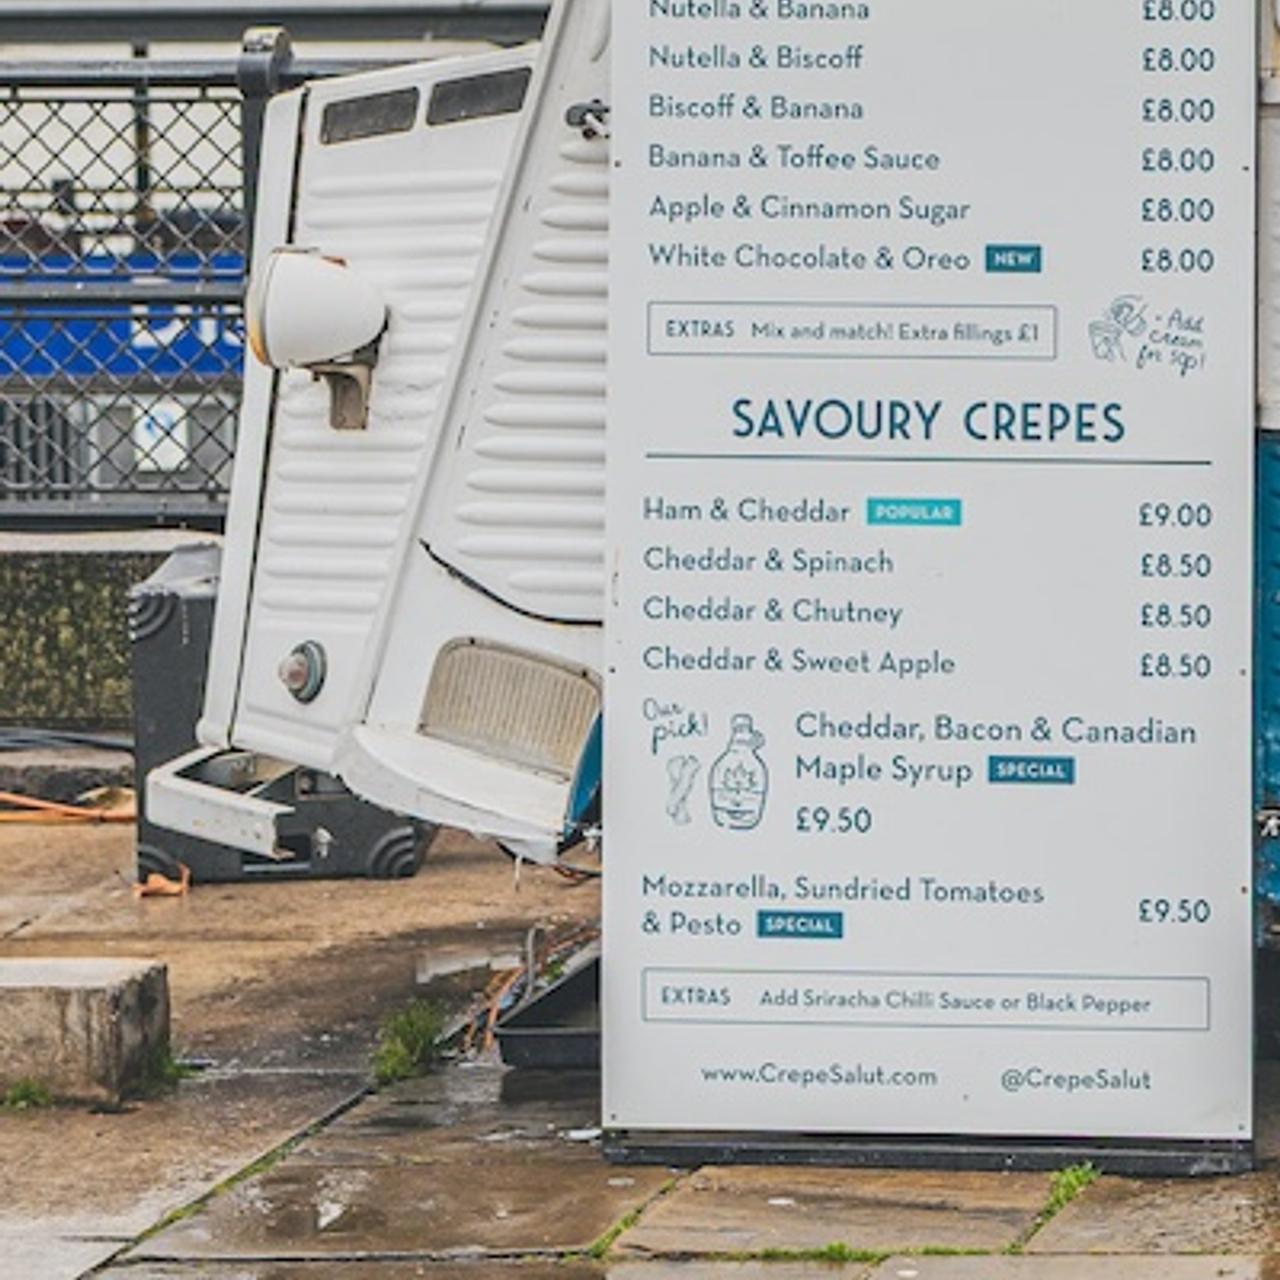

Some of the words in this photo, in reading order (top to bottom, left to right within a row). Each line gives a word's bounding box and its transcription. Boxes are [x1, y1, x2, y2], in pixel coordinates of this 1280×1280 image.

[649, 43, 741, 69] Nutella
[748, 44, 769, 69] &
[777, 43, 864, 70] Biscoff
[1142, 47, 1215, 72] £8.00
[649, 92, 736, 119] Biscoff
[741, 94, 762, 120] &
[770, 95, 864, 120] Banana
[1142, 98, 1215, 123] £8.00
[648, 143, 741, 168] Banana
[748, 143, 768, 169] &
[776, 143, 857, 170] Toffee
[863, 144, 941, 171] Sauce
[1141, 147, 1215, 174] £8.00
[649, 192, 725, 223] Apple
[731, 193, 751, 219] &
[760, 194, 891, 220] Cinnamon
[898, 195, 971, 227] Sugar
[1141, 197, 1215, 223] £8.00
[648, 242, 727, 268] White
[734, 243, 867, 270] Chocolate
[873, 245, 895, 270] &
[902, 245, 971, 271] Oreo
[994, 250, 1034, 267] NEW
[1141, 247, 1215, 274] £8.00
[665, 319, 735, 339] EXTRAS
[751, 321, 785, 339] Mix
[790, 321, 825, 341] and
[829, 321, 894, 341] match!
[898, 322, 949, 341] Extra
[953, 321, 1013, 347] fillings
[1017, 322, 1039, 343] £1
[732, 398, 942, 441] SAVOURY
[963, 401, 1125, 443] CREPES
[643, 496, 702, 521] Ham
[709, 496, 729, 522] &
[737, 497, 851, 523] Cheddar
[875, 504, 954, 520] POPULAR
[1139, 502, 1213, 528] £9.00
[643, 545, 757, 571] Cheddar
[764, 547, 784, 572] &
[792, 547, 894, 579] Spinach
[1141, 552, 1212, 578] £8.50
[642, 595, 756, 622] Cheddar
[764, 597, 783, 622] &
[792, 597, 904, 629] Chutney
[1141, 602, 1212, 629] £8.50
[642, 645, 757, 671] Cheddar
[763, 647, 783, 672] &
[791, 647, 870, 674] Sweet
[878, 649, 956, 680] Apple
[1140, 652, 1212, 679] £8.50
[642, 696, 685, 721] Our
[651, 711, 709, 756] pick!
[795, 711, 926, 743] Cheddar,
[934, 713, 1023, 742] Bacon
[1030, 715, 1052, 742] &
[1061, 716, 1197, 744] Canadian
[796, 753, 883, 786] Maple
[891, 754, 974, 789] Syrup
[996, 761, 1066, 779] SPECIAL
[796, 806, 872, 834] £9.50
[642, 873, 787, 901] Mozzarella,
[794, 875, 911, 901] Sundried
[919, 877, 1045, 904] Tomatoes
[641, 909, 661, 935] &
[670, 910, 742, 936] Pesto
[765, 916, 834, 933] SPECIAL
[1139, 898, 1211, 924] £9.50
[661, 985, 732, 1007] EXTRAS
[759, 988, 799, 1007] Add
[803, 988, 881, 1009] Sriracha
[884, 989, 934, 1010] Chilli
[939, 991, 996, 1010] Sauce
[999, 997, 1021, 1011] or
[1026, 991, 1077, 1013] Black
[1081, 993, 1152, 1017] Pepper
[700, 1062, 938, 1089] www.CrepeSalut.com
[1000, 1066, 1151, 1093] @CrepeSalut
